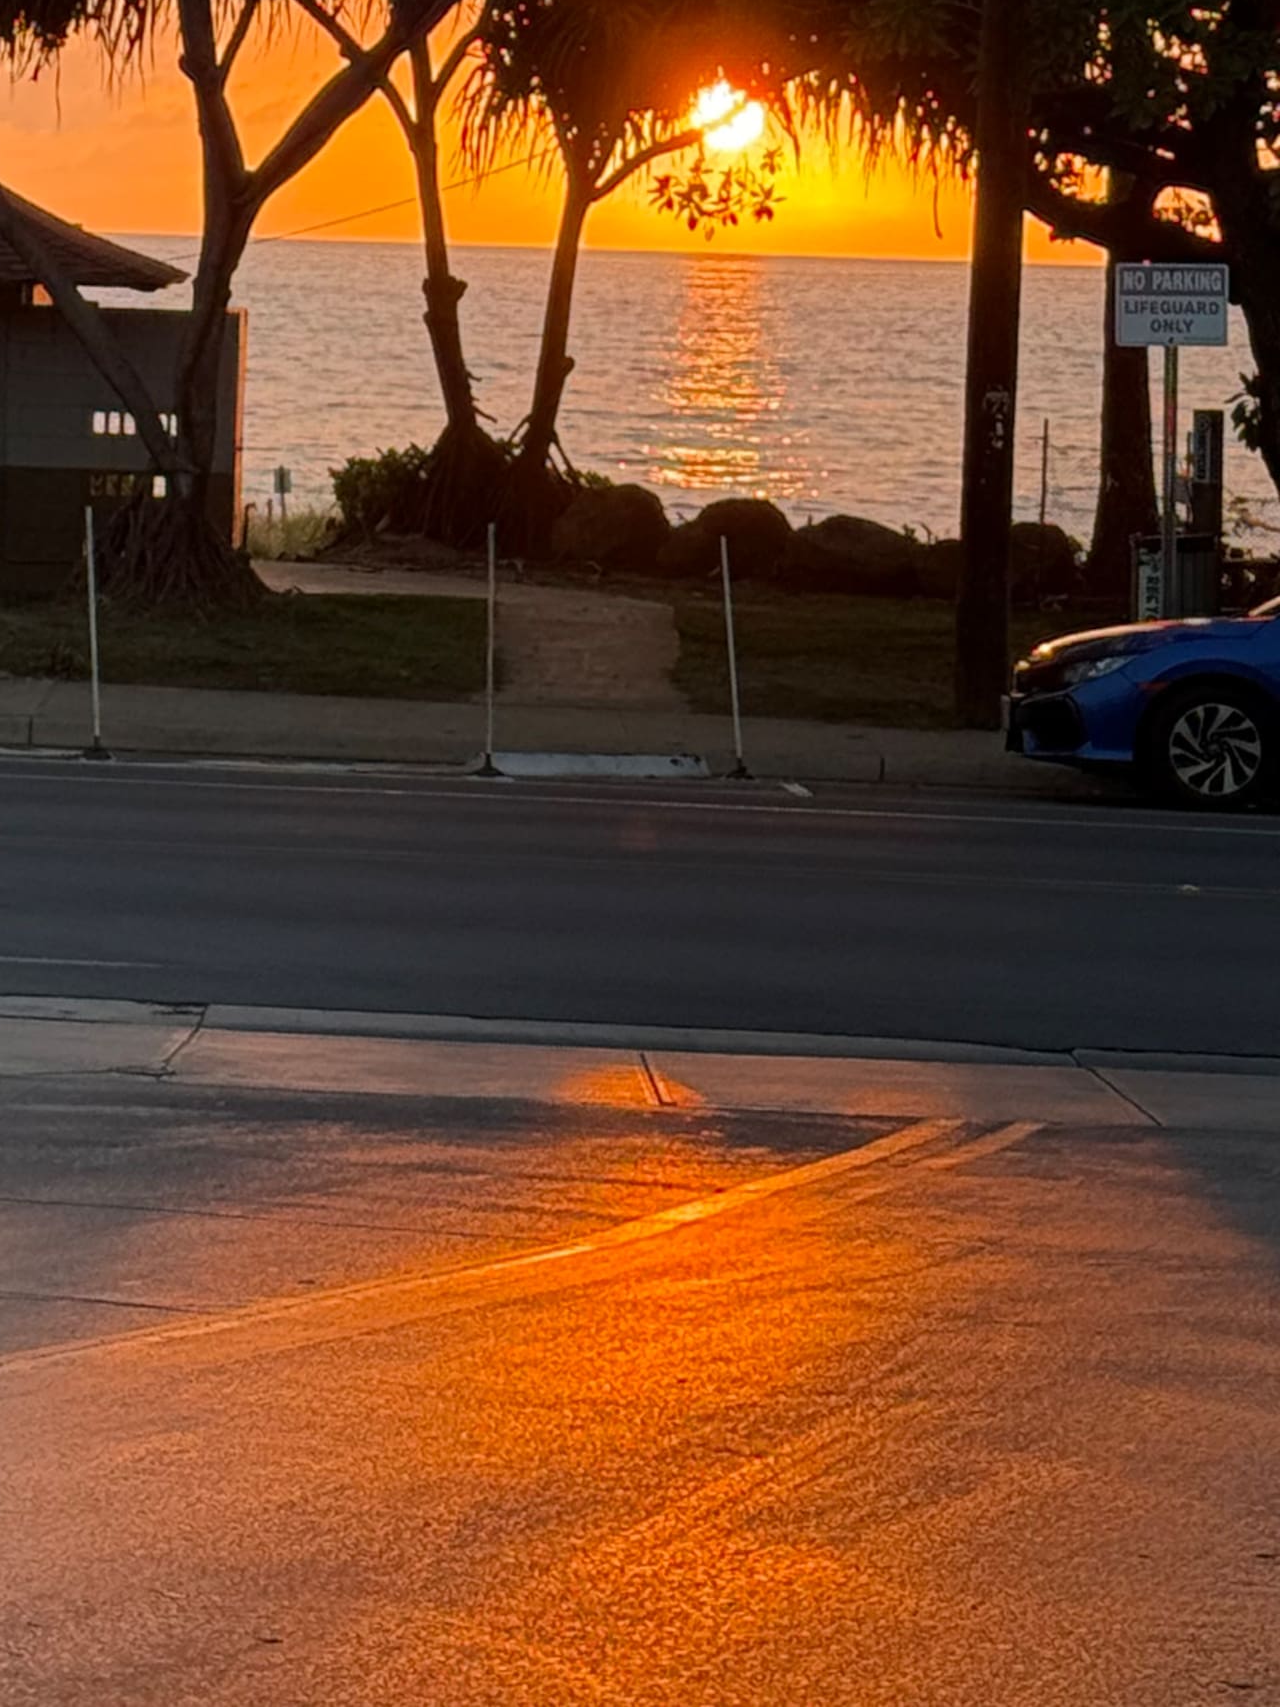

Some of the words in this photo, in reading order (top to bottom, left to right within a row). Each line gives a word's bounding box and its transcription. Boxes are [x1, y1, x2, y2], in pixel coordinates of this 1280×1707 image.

[1123, 270, 1146, 291] NO
[1151, 270, 1223, 292] PARKING
[1123, 300, 1220, 315] LIFEGUARD
[1150, 319, 1195, 333] ONLY
